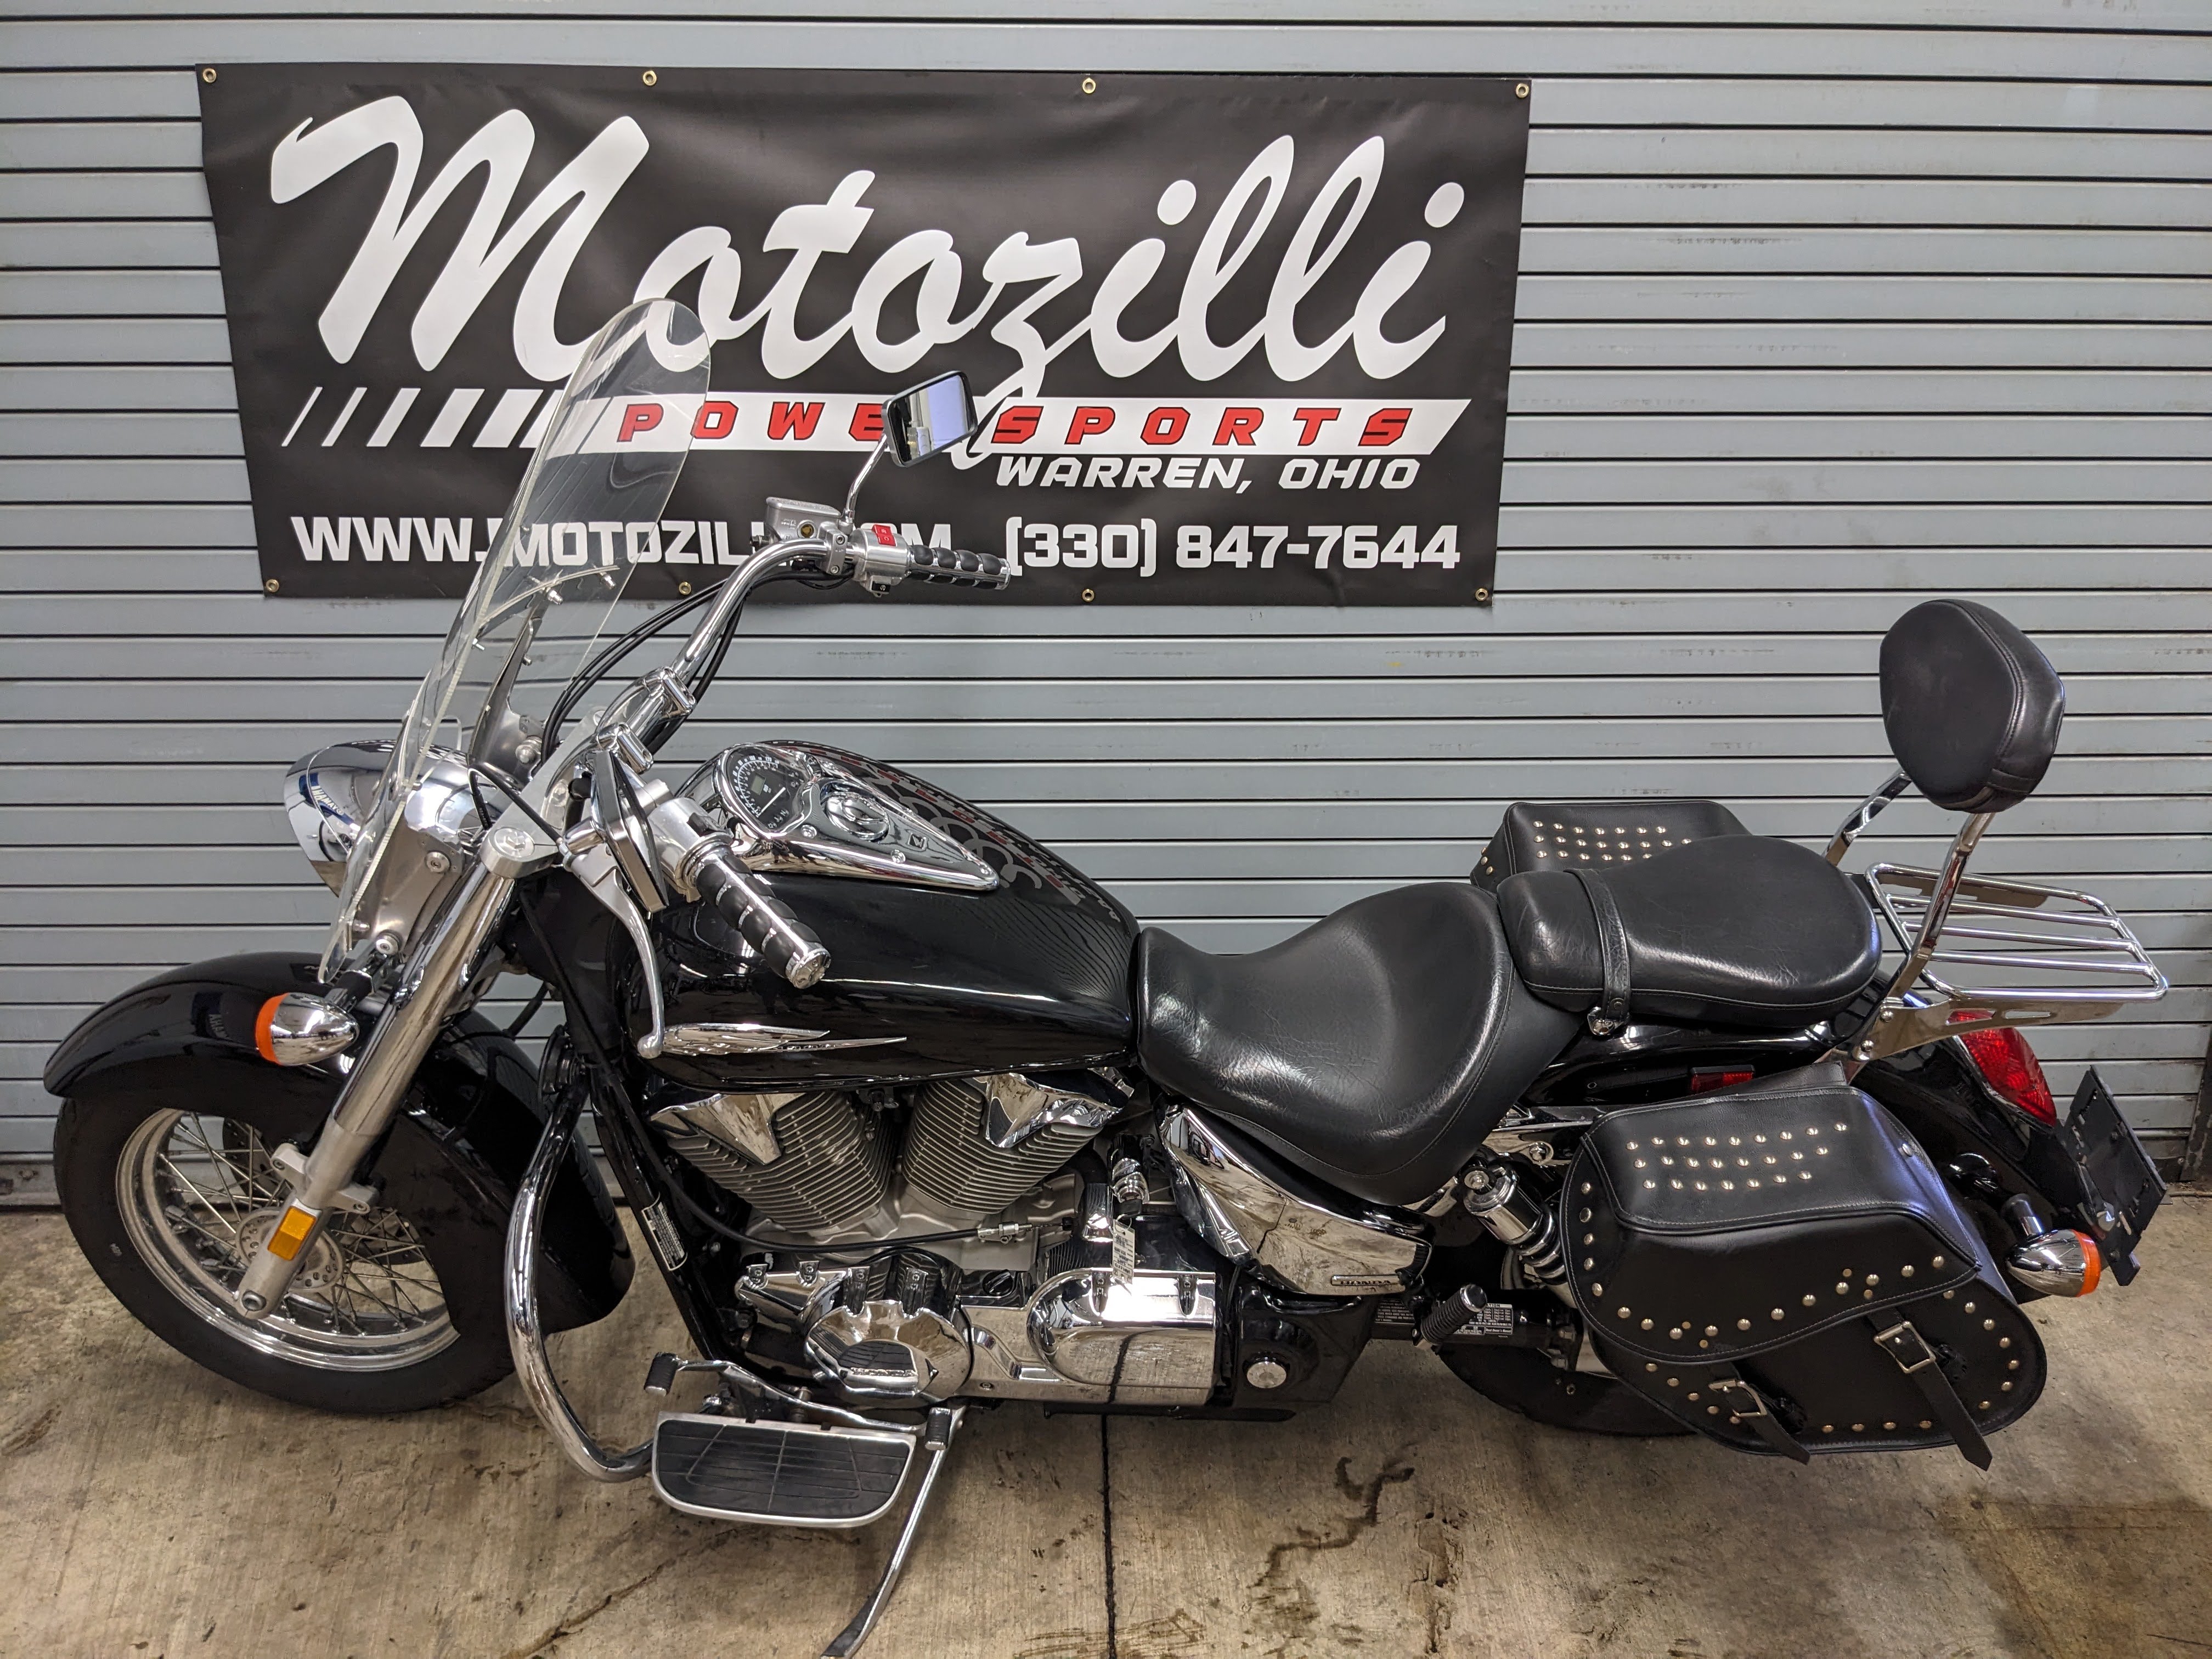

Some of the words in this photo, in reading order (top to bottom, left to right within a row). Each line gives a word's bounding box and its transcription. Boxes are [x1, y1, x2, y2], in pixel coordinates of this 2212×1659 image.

[271, 95, 1464, 470] Motozilli
[996, 456, 1252, 494] WARREN,
[1278, 458, 1421, 490] OHIO
[290, 516, 952, 568] WWW.MOTOZILM
[1005, 516, 1158, 578] (330)
[1175, 524, 1461, 569] 847-7644
